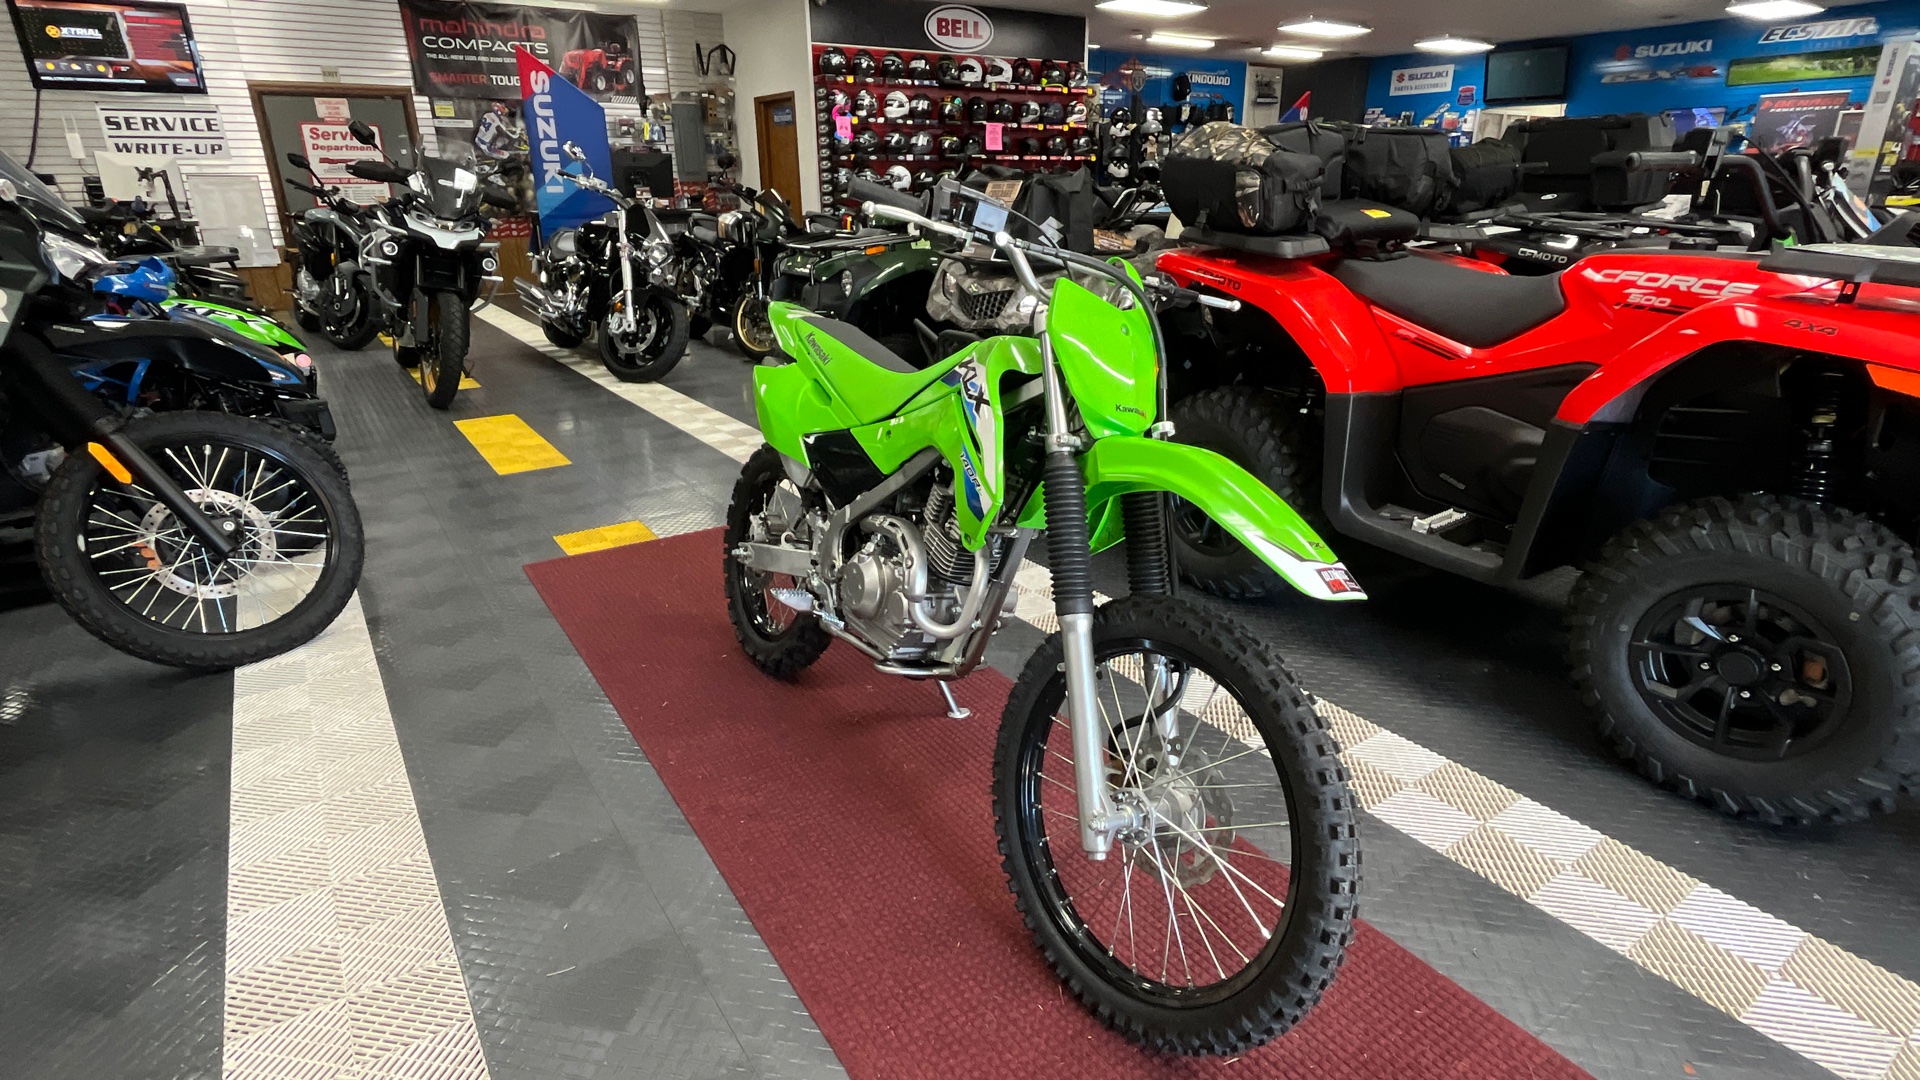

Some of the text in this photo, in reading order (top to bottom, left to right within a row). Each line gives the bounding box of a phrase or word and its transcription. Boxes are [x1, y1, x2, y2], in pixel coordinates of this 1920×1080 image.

[419, 18, 546, 39] mahindra
[937, 17, 983, 39] BELL
[1759, 18, 1877, 43] ECSTAR
[422, 36, 549, 54] COMPACTS
[1635, 39, 1712, 58] SUZUKI
[490, 74, 521, 87] TOUG
[1186, 72, 1231, 86] KINGQUAD
[1408, 70, 1449, 81] SUZUKI
[104, 115, 221, 132] SERVICE
[530, 70, 564, 193] SUZUKI
[309, 127, 354, 141] Servi
[114, 142, 223, 155] WRITE-UP
[1517, 247, 1568, 265] CFMOTO
[1599, 268, 1759, 298] CFORCE
[1626, 292, 1672, 308] 500
[805, 331, 833, 366] Kawasaki
